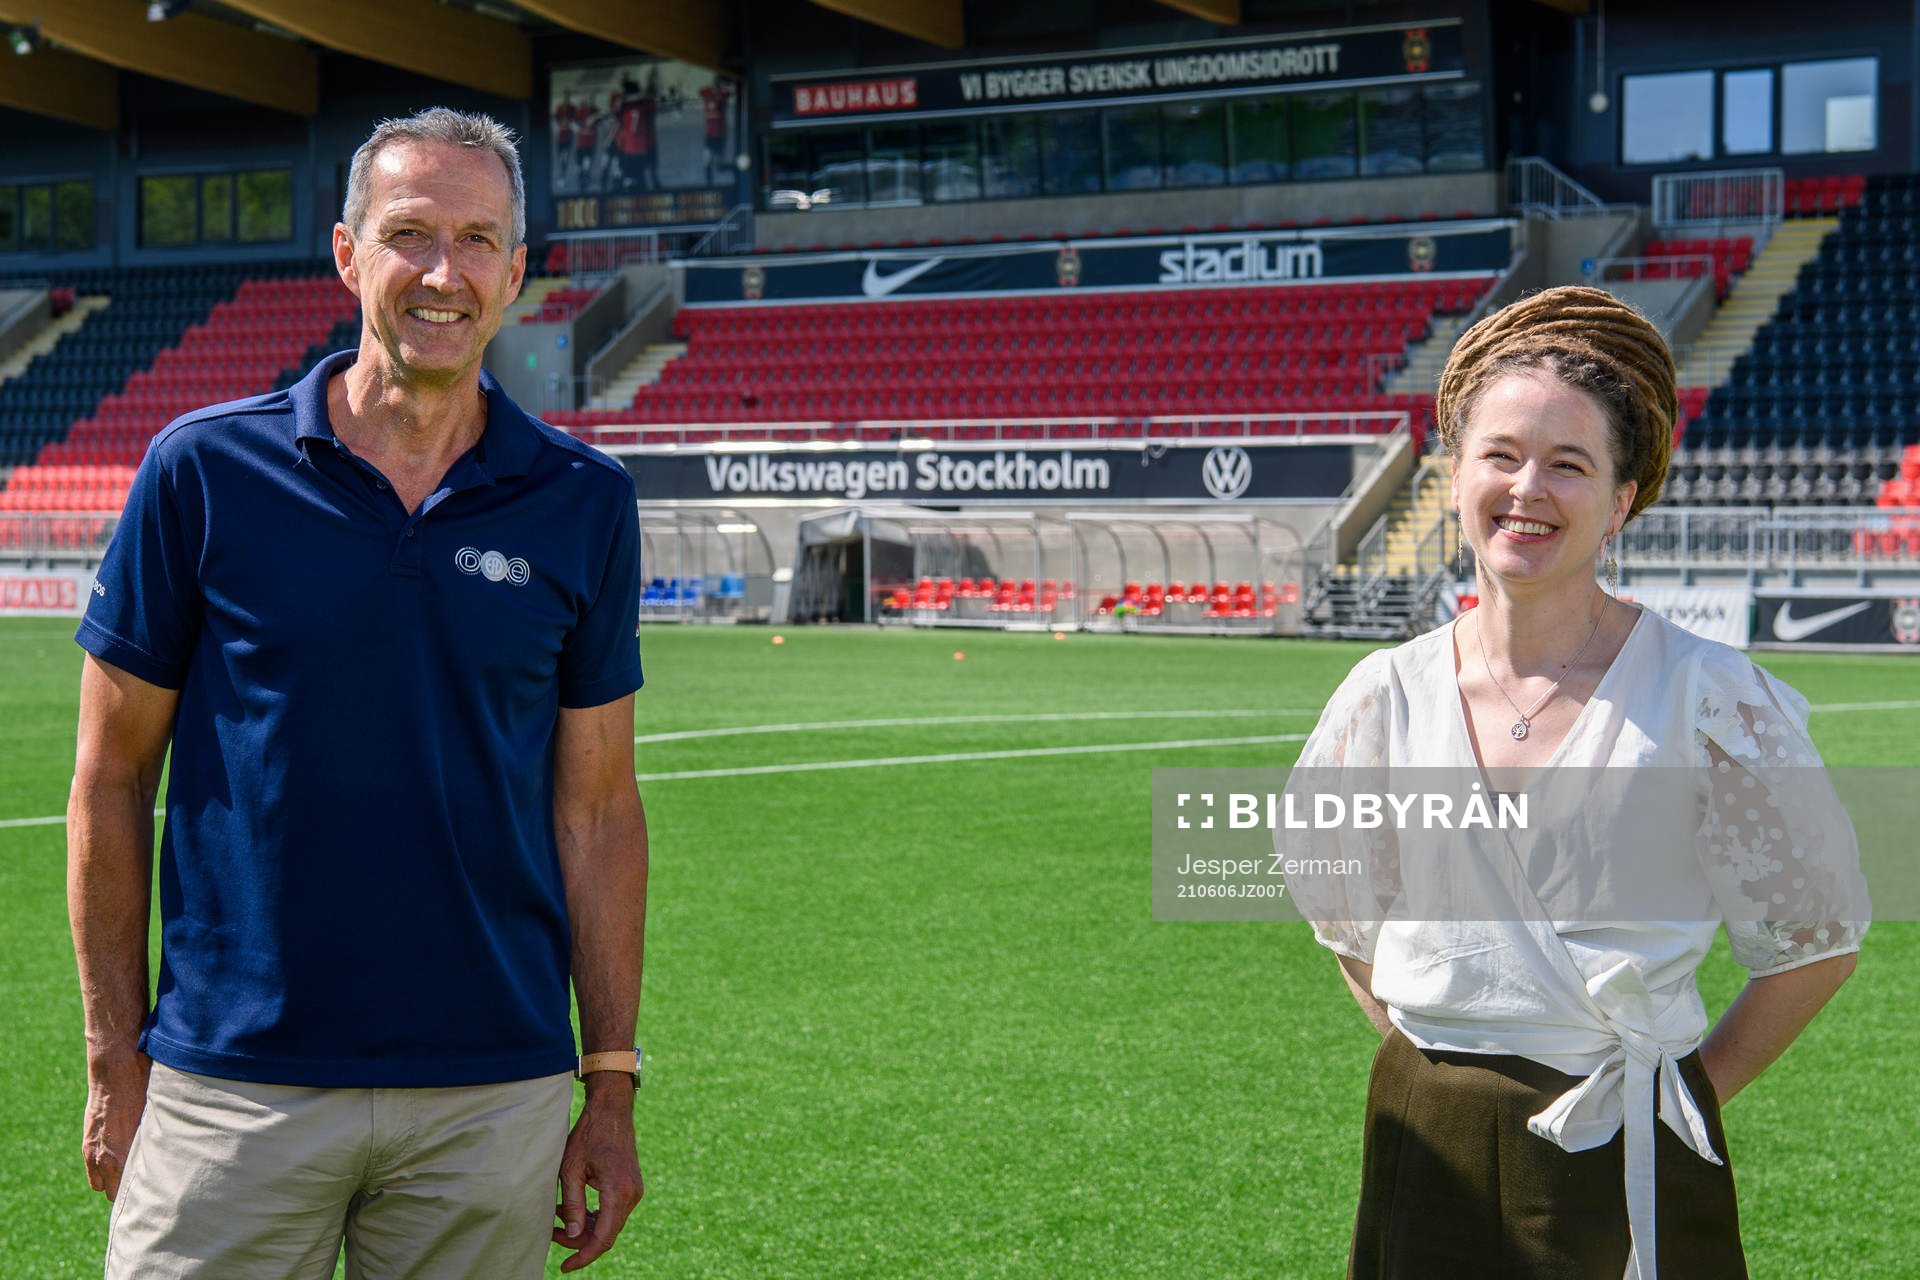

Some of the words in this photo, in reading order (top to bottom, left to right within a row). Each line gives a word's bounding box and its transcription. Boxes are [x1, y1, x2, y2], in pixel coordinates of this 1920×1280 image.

[960, 73, 982, 100] VI
[985, 67, 1066, 99] BYGGER
[1069, 60, 1151, 93] SVENSK
[1154, 44, 1341, 87] UNGDOMSIDROTT
[795, 79, 917, 113] BAUHAUS
[1159, 239, 1323, 283] stadium
[705, 453, 909, 498] Volkswagen
[915, 451, 1110, 491] Stockholm
